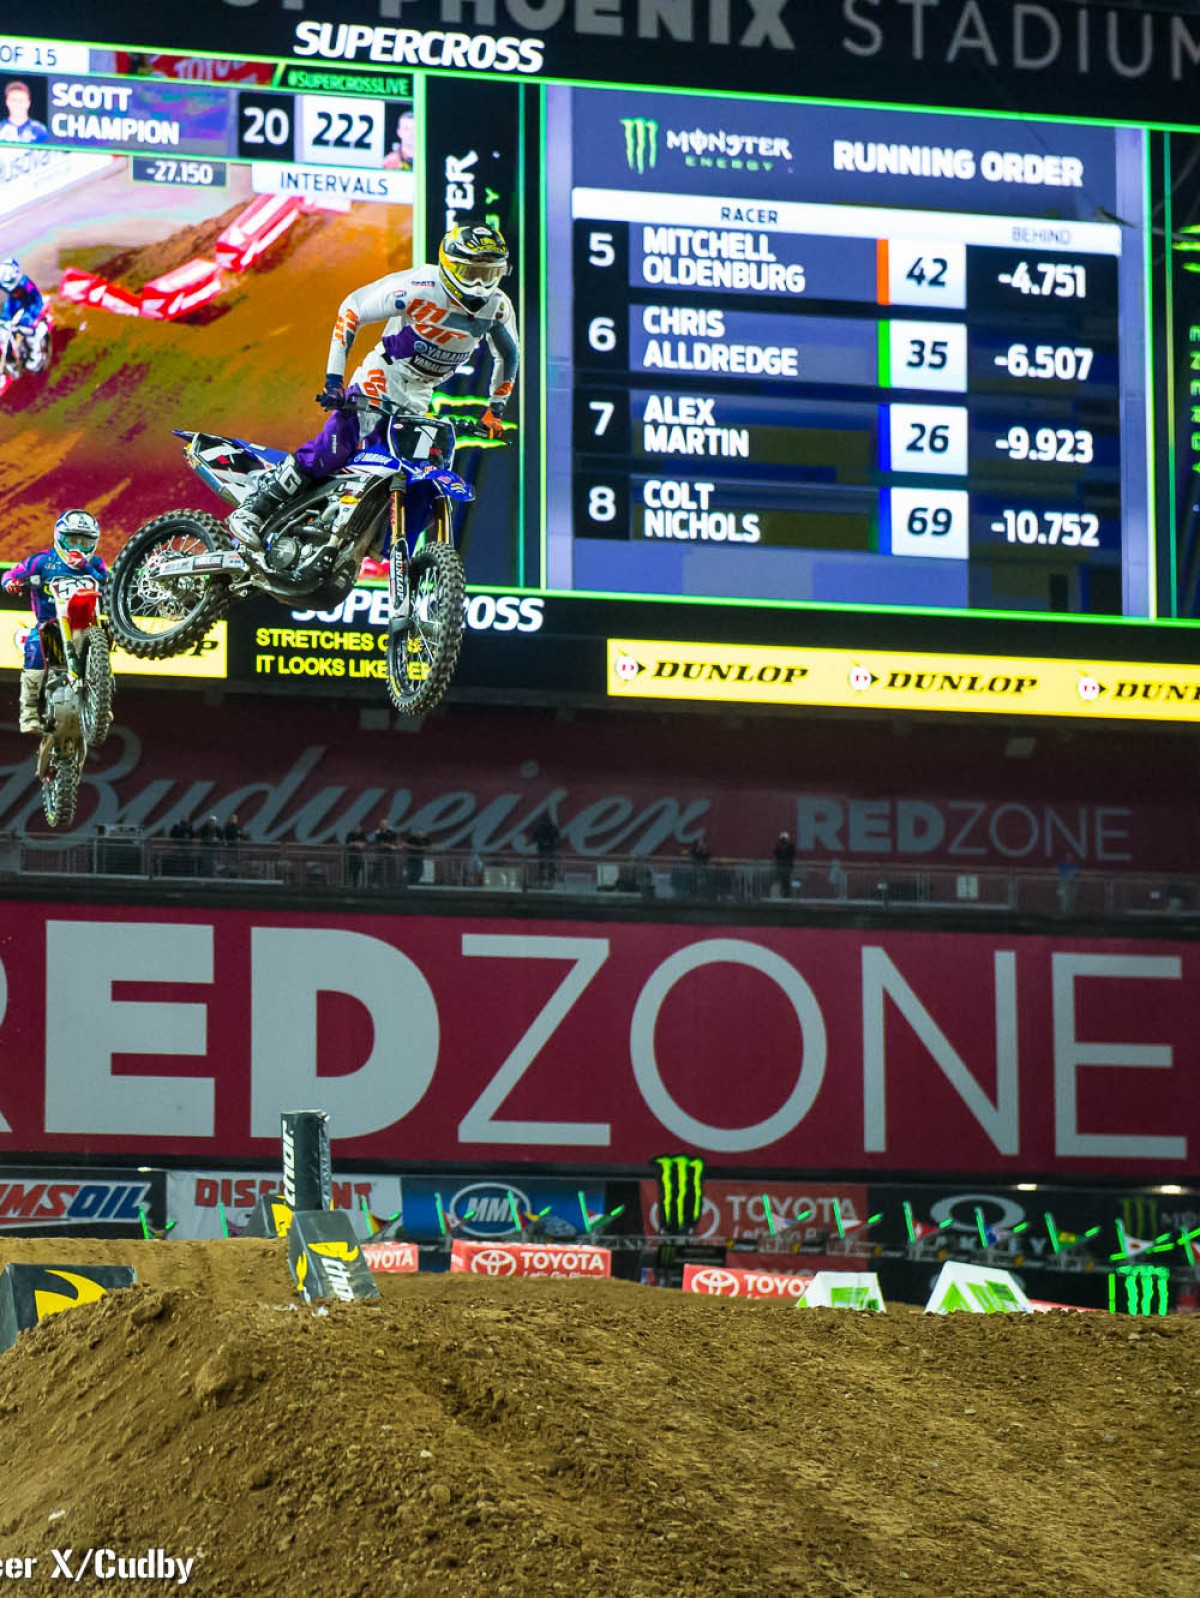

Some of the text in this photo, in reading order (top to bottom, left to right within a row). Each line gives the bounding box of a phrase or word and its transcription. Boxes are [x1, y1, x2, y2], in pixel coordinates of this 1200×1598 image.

[0, 46, 22, 64] OF
[34, 47, 57, 67] 15
[293, 21, 546, 73] SUPERCROSS
[52, 82, 132, 112] SCOTT
[288, 69, 409, 96] #SUPERCROSSLIVE
[52, 116, 180, 146] CHAMPION
[243, 107, 290, 145] 20
[312, 110, 374, 150] 222
[666, 127, 793, 161] MONSTER
[145, 161, 214, 186] -27.150
[833, 139, 1084, 187] RUNNING ORDER
[280, 173, 390, 197] INTERVALS
[720, 206, 779, 225] RACER
[589, 233, 615, 267] 5
[643, 226, 777, 263] MITCHELL
[1011, 226, 1072, 245] BEHIND
[643, 256, 806, 293] OLDENBURG
[906, 257, 949, 288] 42
[998, 261, 1087, 299] -4.751
[588, 318, 617, 351] 6
[643, 306, 725, 338] CHRIS
[643, 340, 799, 377] ALLDREDGE
[906, 339, 948, 370] 35
[994, 343, 1094, 381] -6.507
[588, 401, 616, 436] 7
[643, 394, 716, 426] ALEX
[413, 425, 438, 459] 1
[643, 425, 750, 459] MARTIN
[905, 422, 951, 454] 26
[995, 426, 1094, 464] -9.923
[588, 485, 617, 522] 8
[643, 479, 715, 511] COLT
[644, 509, 761, 543] NICHOLS
[907, 507, 953, 537] 69
[991, 509, 1100, 547] -10.752
[256, 628, 373, 651] STRETCHES
[256, 654, 274, 673] IT
[278, 656, 345, 676] LOOKS
[349, 659, 388, 679] LIKE
[653, 660, 809, 685] DUNLOP
[887, 671, 1038, 695] DUNLOP
[795, 797, 1133, 862] REDZONE
[726, 1195, 861, 1223] TOYOTA
[365, 1249, 414, 1269] OYOTA
[521, 1252, 605, 1271] TOYOTA
[744, 1274, 810, 1296] TOYO
